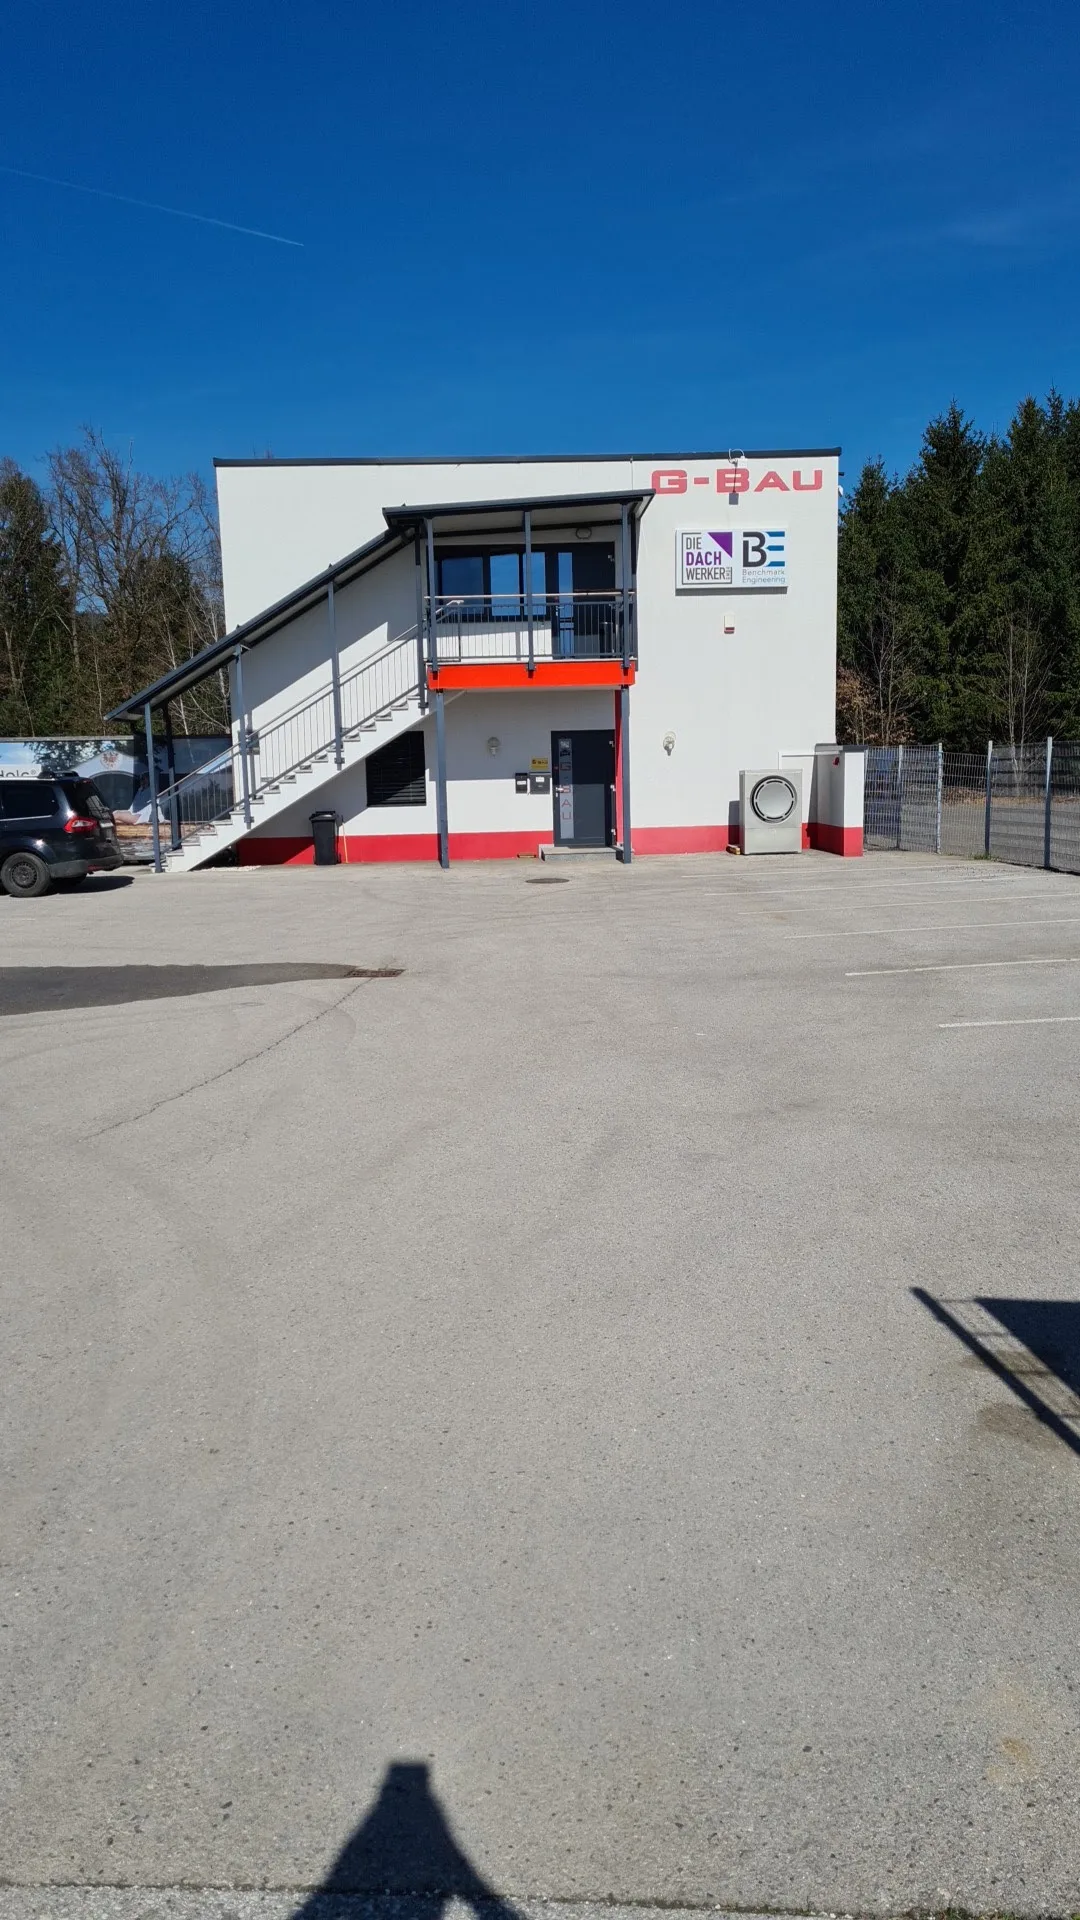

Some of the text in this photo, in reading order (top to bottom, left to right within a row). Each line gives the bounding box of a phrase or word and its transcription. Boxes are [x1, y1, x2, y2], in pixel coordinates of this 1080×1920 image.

[652, 469, 823, 494] G-BAU
[686, 537, 702, 550] DIE
[686, 551, 722, 566] DACH
[686, 567, 726, 580] WERKER
